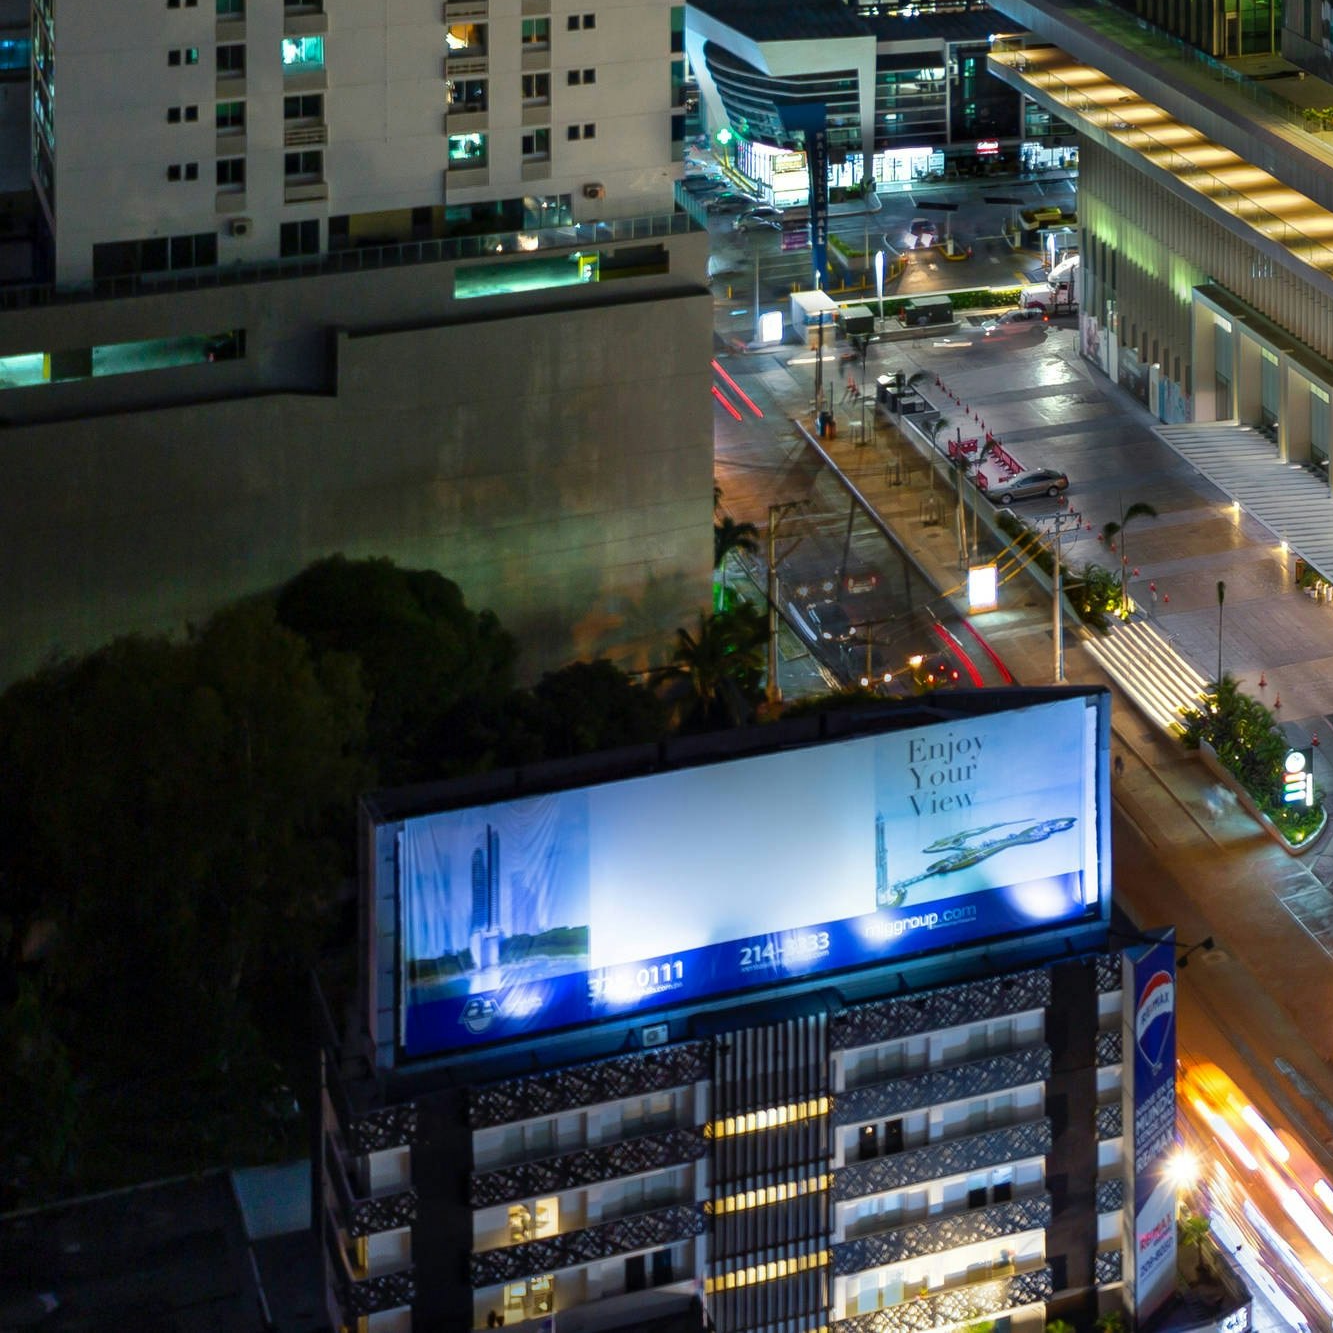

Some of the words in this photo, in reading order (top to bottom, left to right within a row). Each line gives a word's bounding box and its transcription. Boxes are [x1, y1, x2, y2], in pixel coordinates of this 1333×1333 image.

[816, 210, 825, 245] MALL
[908, 732, 988, 765] Enjoy
[907, 764, 977, 790] Your
[907, 791, 976, 817] View
